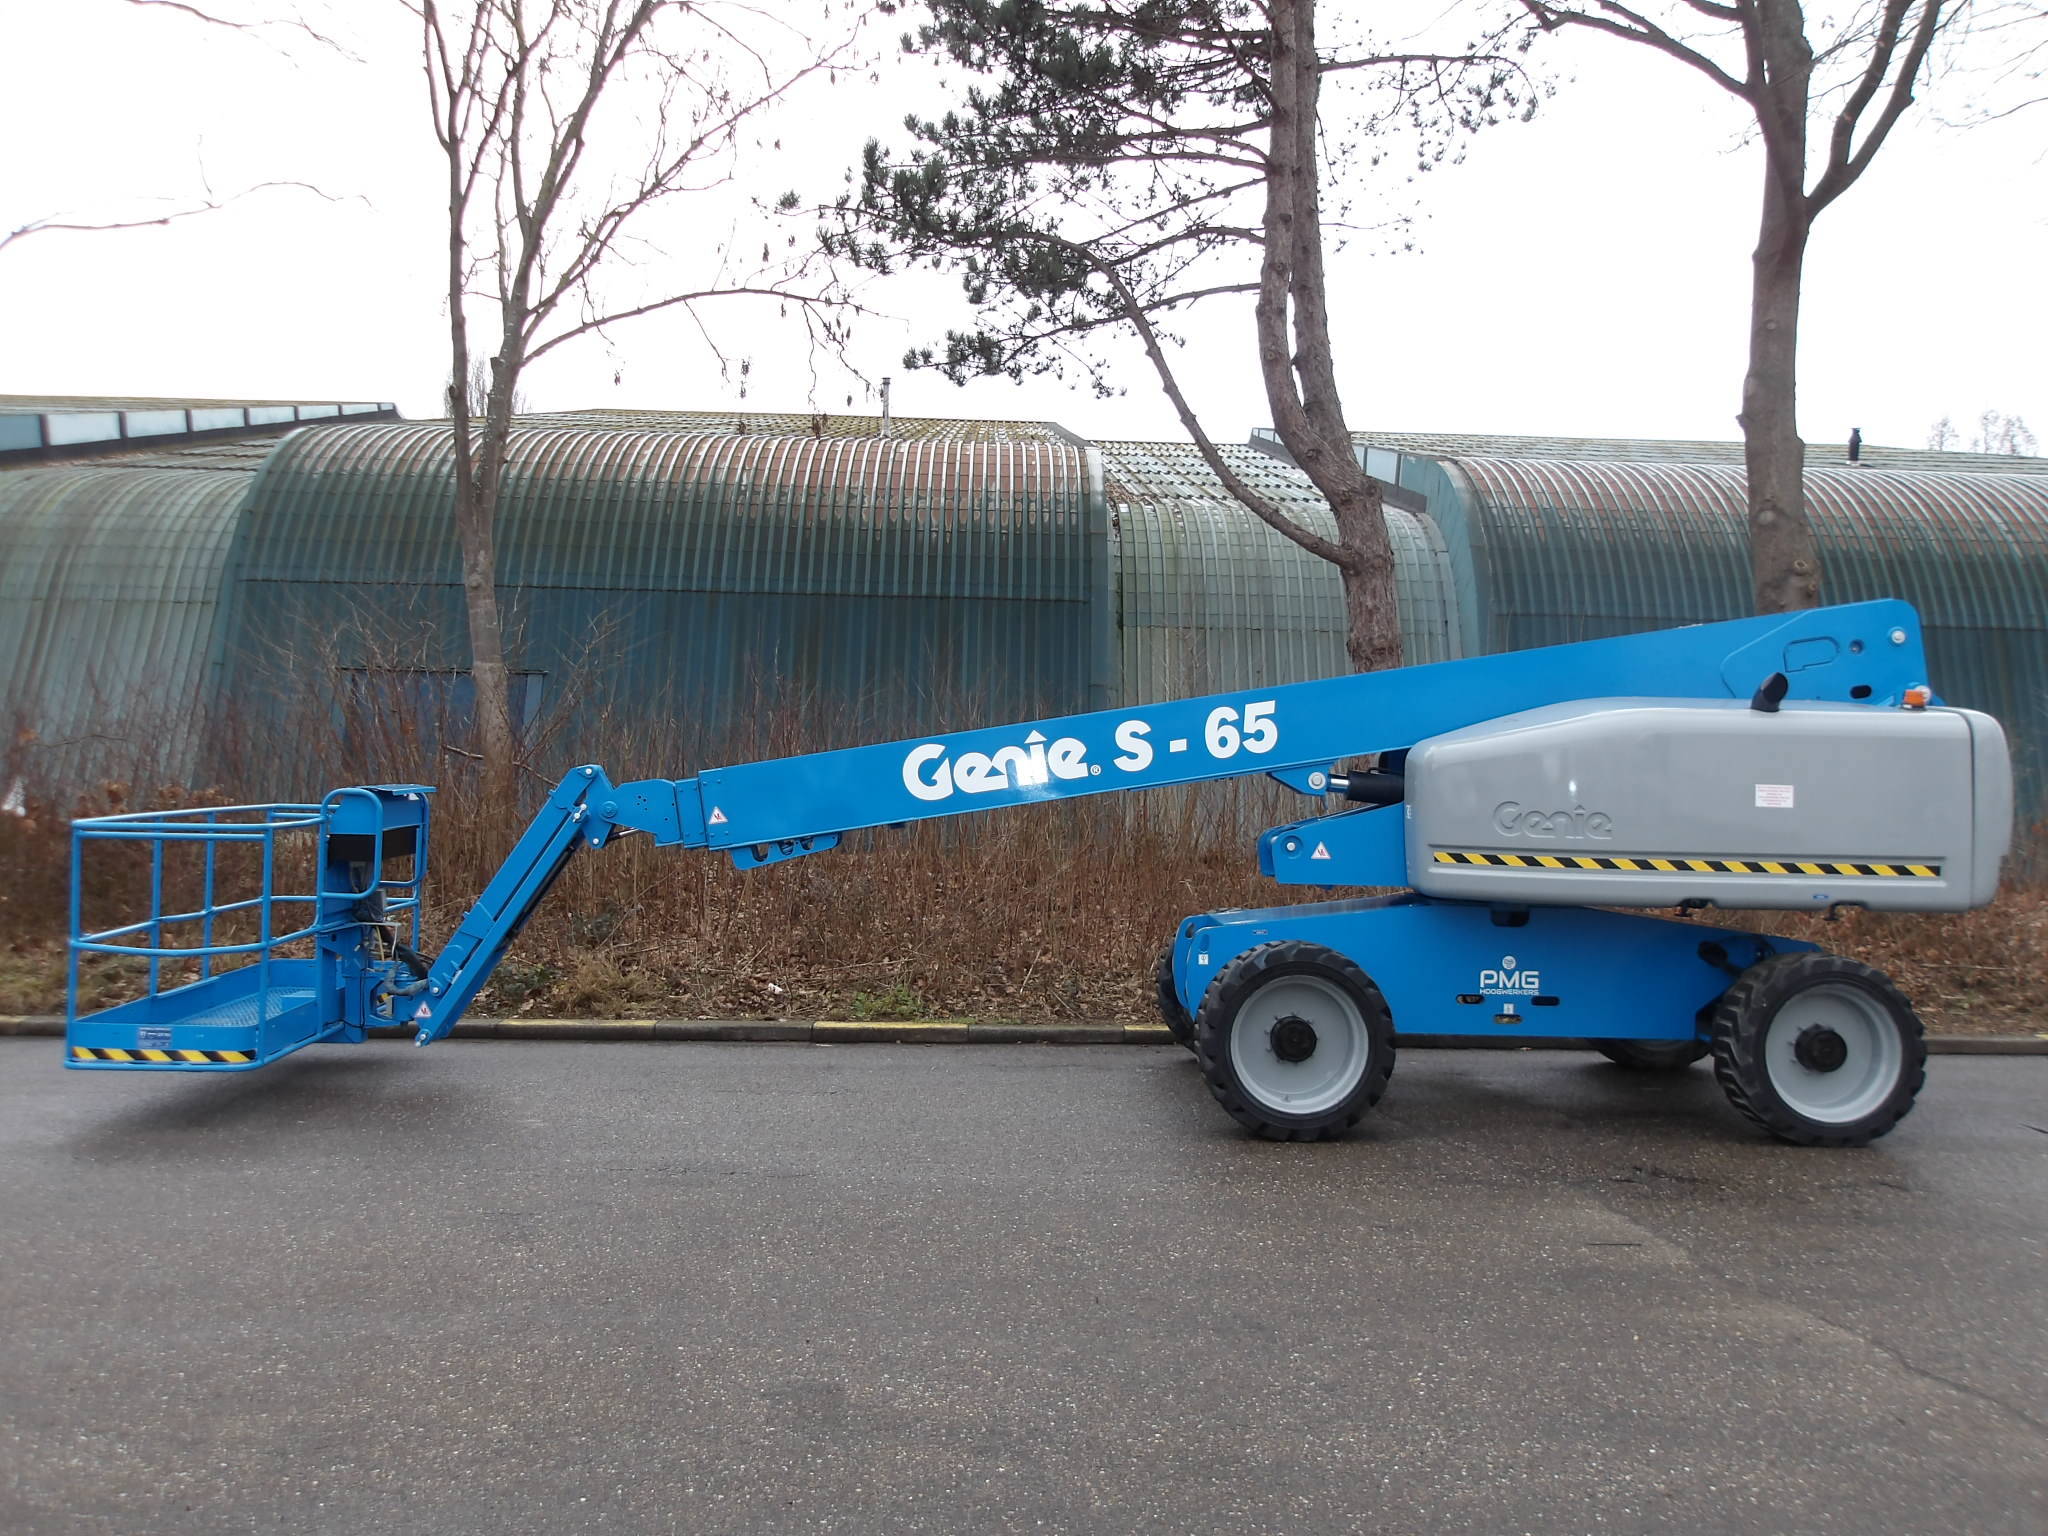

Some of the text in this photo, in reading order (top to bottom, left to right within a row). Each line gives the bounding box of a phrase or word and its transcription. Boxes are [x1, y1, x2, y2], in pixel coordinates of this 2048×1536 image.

[902, 730, 1088, 801] Genie
[1113, 719, 1154, 772] S
[1205, 700, 1278, 759] 65
[1493, 801, 1614, 840] Genie
[1480, 970, 1540, 989] PMG
